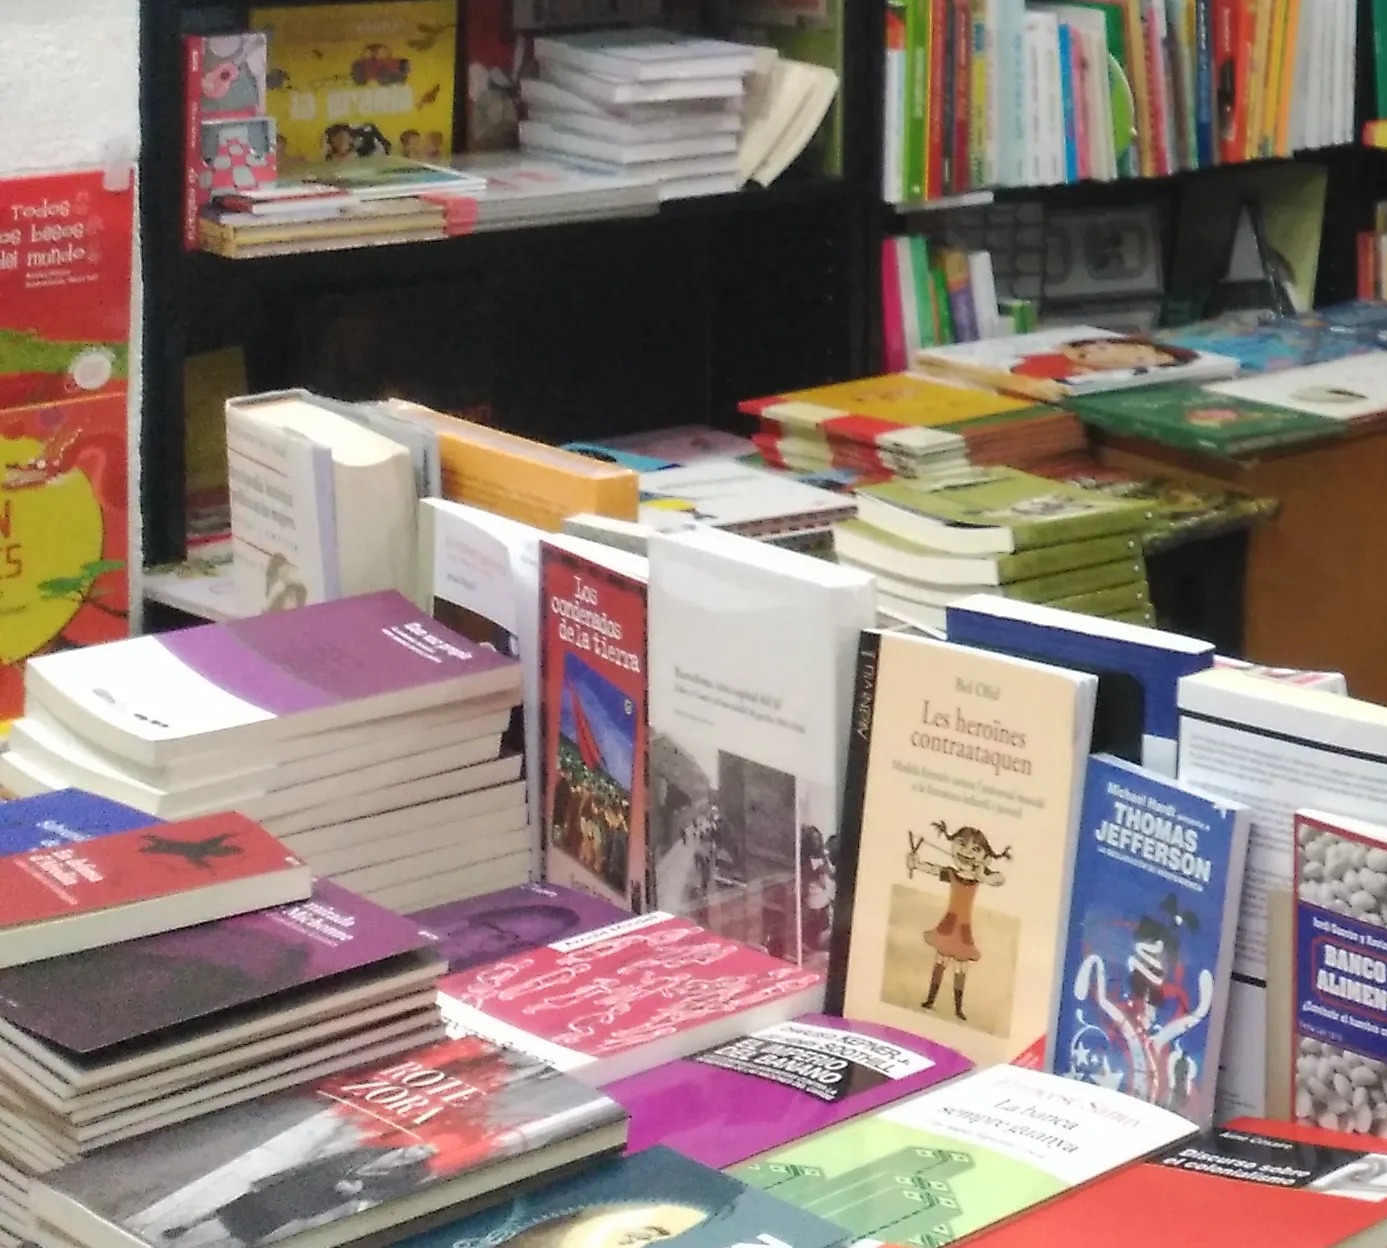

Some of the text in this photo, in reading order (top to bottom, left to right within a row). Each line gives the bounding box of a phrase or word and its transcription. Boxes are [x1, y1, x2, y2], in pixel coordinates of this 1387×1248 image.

[574, 575, 597, 605] Los
[922, 700, 1027, 748] Les heroïnes
[910, 730, 1033, 776] contraataquen
[1114, 801, 1199, 852] THOMAS
[1095, 820, 1212, 882] JEFFERSON
[1324, 943, 1387, 984] BANCO
[380, 1061, 486, 1108] ROTE
[752, 1053, 843, 1084] BANANO
[340, 1080, 444, 1125] ZORA
[993, 1098, 1080, 1132] La banca
[1162, 1156, 1187, 1166] el
[1178, 1148, 1312, 1179] Discurso sobre
